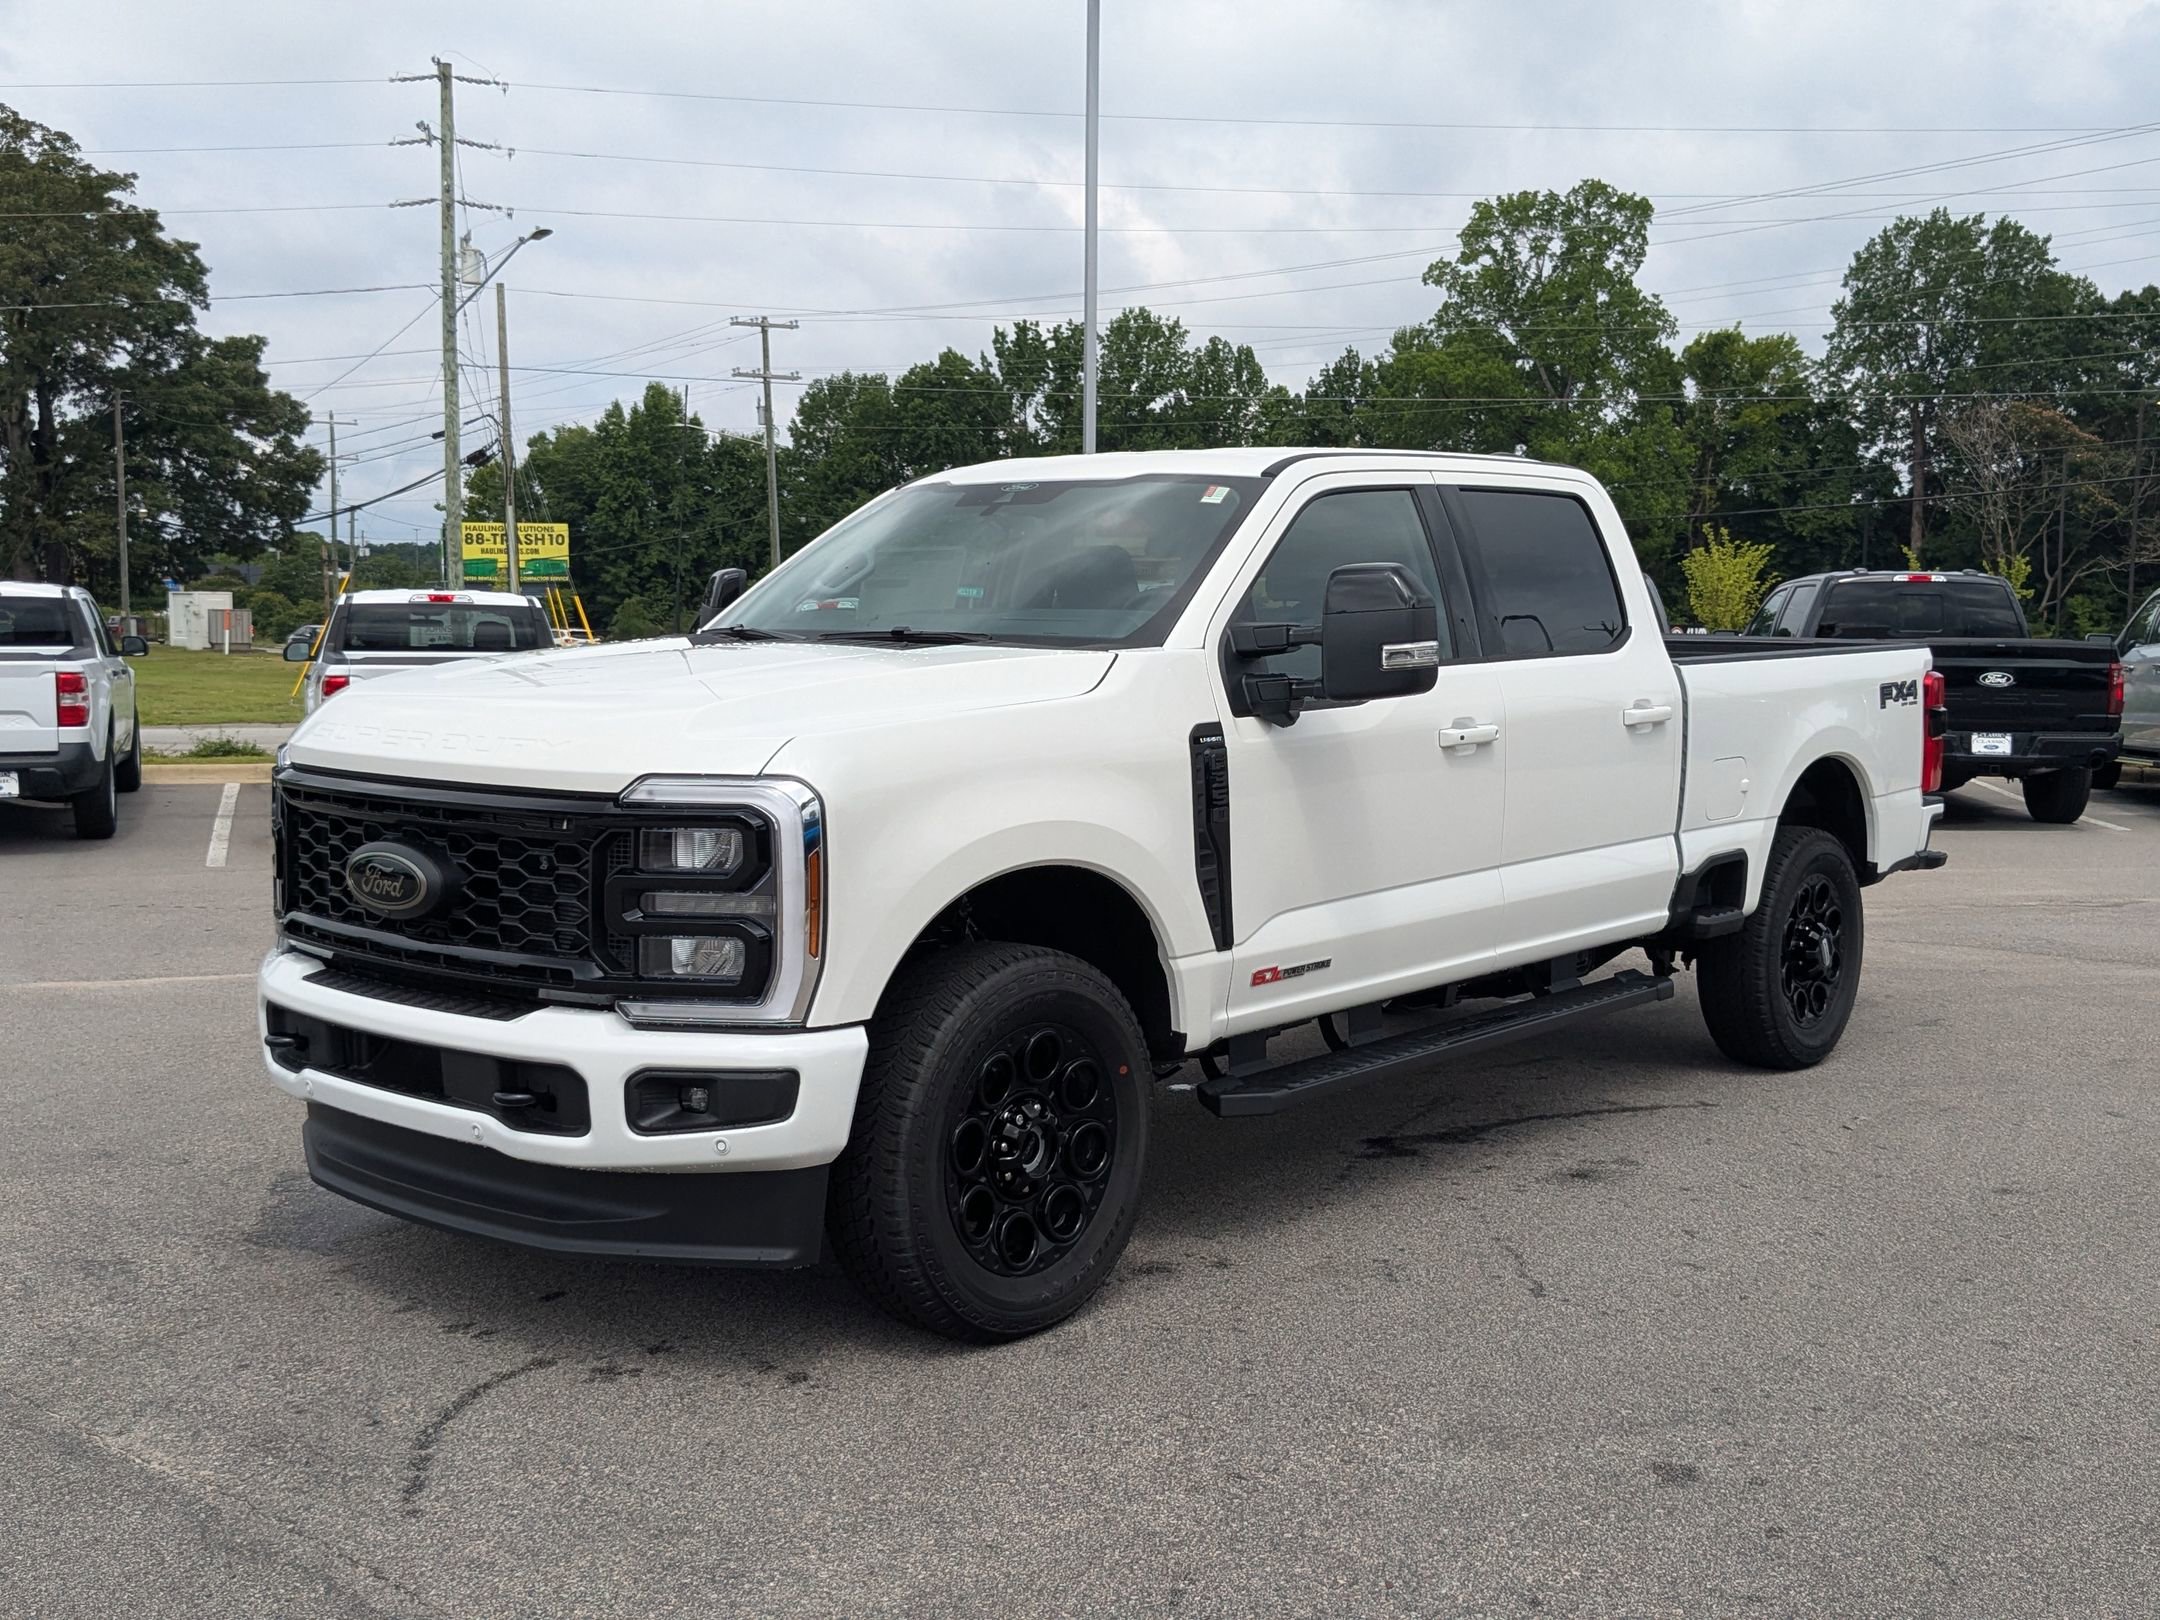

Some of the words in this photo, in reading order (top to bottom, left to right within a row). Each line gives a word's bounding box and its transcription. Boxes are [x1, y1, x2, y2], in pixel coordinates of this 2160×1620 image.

[465, 525, 505, 533] HAULING
[517, 525, 555, 533] LUTIONS
[1985, 672, 2008, 683] Ford
[1880, 680, 1917, 709] FX4
[361, 863, 404, 898] Ford
[1283, 964, 1306, 976] POWER
[1305, 959, 1332, 972] STROKE
